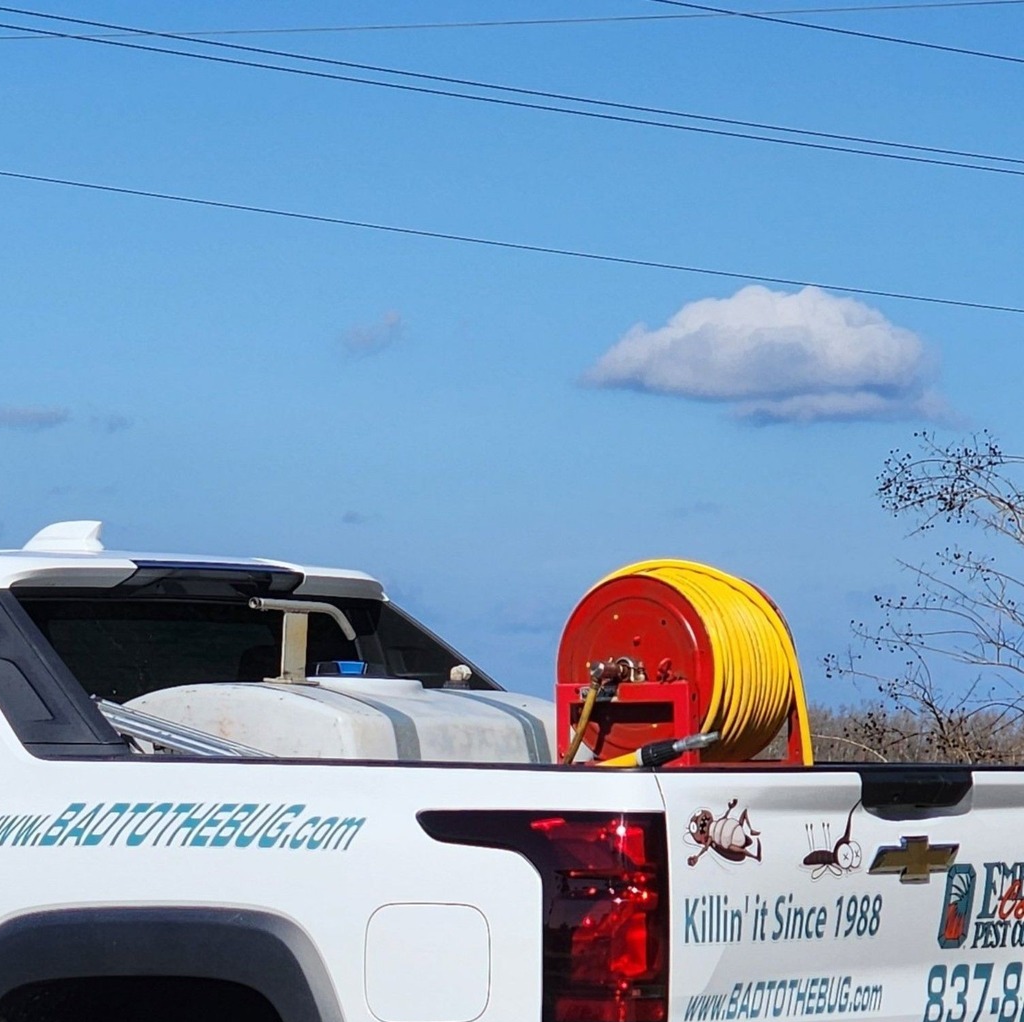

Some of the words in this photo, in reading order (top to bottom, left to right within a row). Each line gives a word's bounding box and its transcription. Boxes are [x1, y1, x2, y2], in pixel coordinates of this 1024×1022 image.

[684, 895, 750, 944] Killin'
[752, 894, 769, 941] it
[772, 893, 827, 941] Since
[834, 894, 883, 938] 1988
[970, 920, 1011, 949] PEST
[684, 976, 883, 1022] www.BADTOTHEBUG.com
